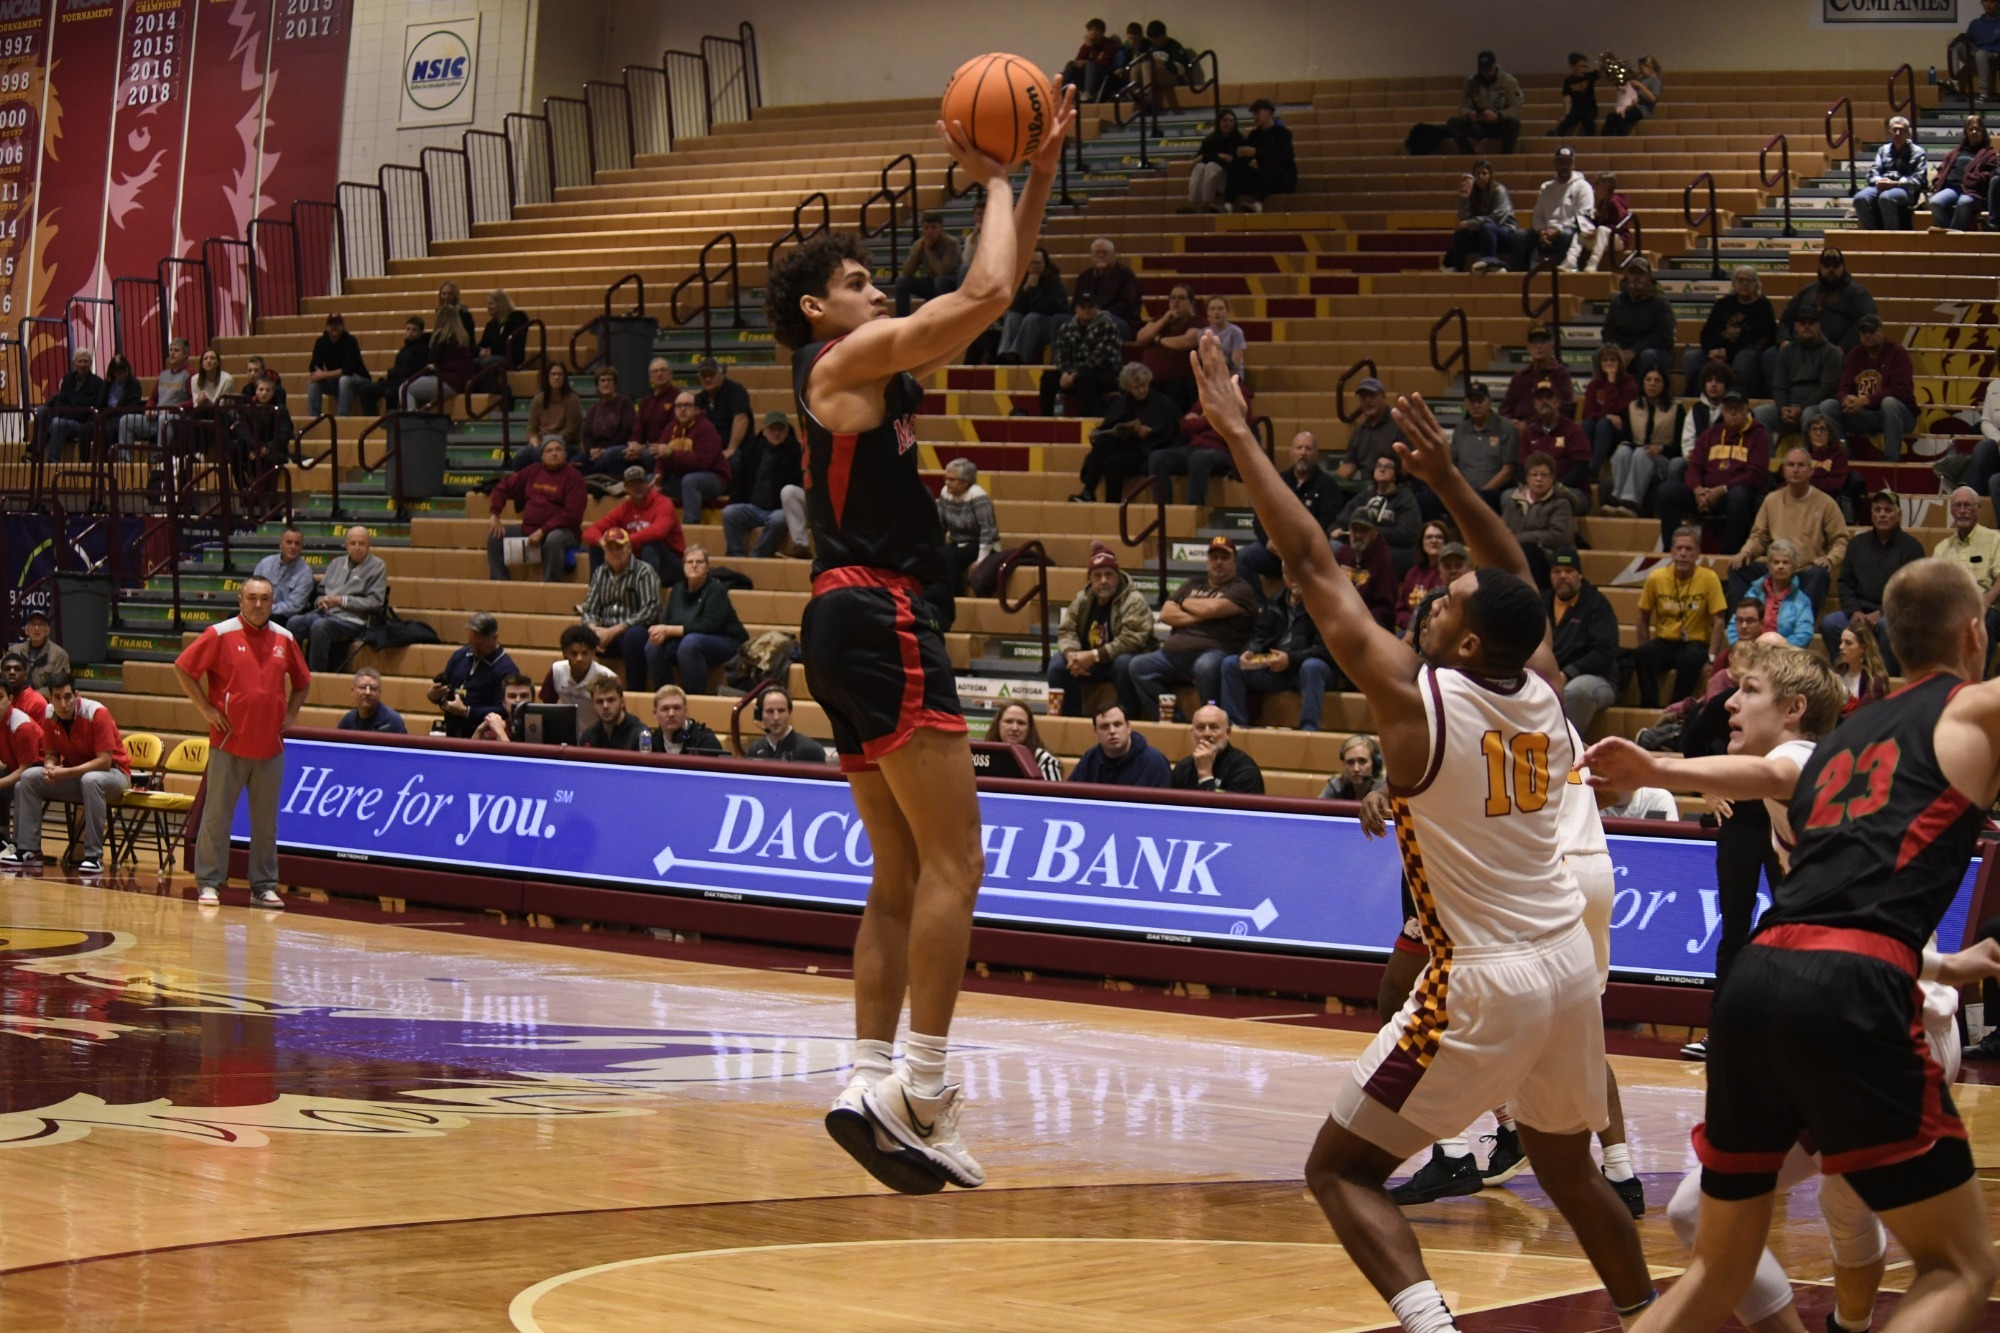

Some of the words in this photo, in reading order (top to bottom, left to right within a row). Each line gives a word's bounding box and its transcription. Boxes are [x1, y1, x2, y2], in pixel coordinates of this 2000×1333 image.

[62, 8, 113, 23] TOURNAMENT
[136, 1, 181, 14] CHAMPIONS
[0, 19, 42, 32] OURNAMENT
[135, 11, 176, 35] 2014
[285, 16, 331, 39] 2017
[133, 35, 174, 58] 2015
[131, 59, 172, 82] 2016
[412, 56, 466, 80] NSIC
[1, 71, 29, 93] 998
[128, 83, 170, 105] 2018
[0, 108, 26, 129] 000
[1023, 86, 1043, 155] Wilson
[0, 145, 23, 165] 06
[3, 182, 18, 202] 11
[1, 203, 18, 211] OUND
[0, 219, 17, 239] 14
[738, 331, 775, 342] ETHAN
[1134, 581, 1160, 590] TRONG.
[167, 607, 211, 621] EHANOL
[111, 635, 153, 649] ETHANOL
[957, 683, 988, 692] AGTEGRA
[1012, 686, 1043, 696] AGTEGRA
[128, 740, 151, 758] NSU
[181, 745, 206, 762] NSU
[1481, 730, 1550, 817] 10
[1804, 737, 1901, 830] 23
[281, 766, 383, 821] Here
[374, 774, 454, 837] for
[455, 792, 556, 846] you.
[1027, 818, 1232, 897] BANK
[703, 890, 743, 901] DAKTRONICS
[1146, 932, 1192, 943] DAKTRONICS
[1654, 974, 1705, 985] DAKTRONICS
